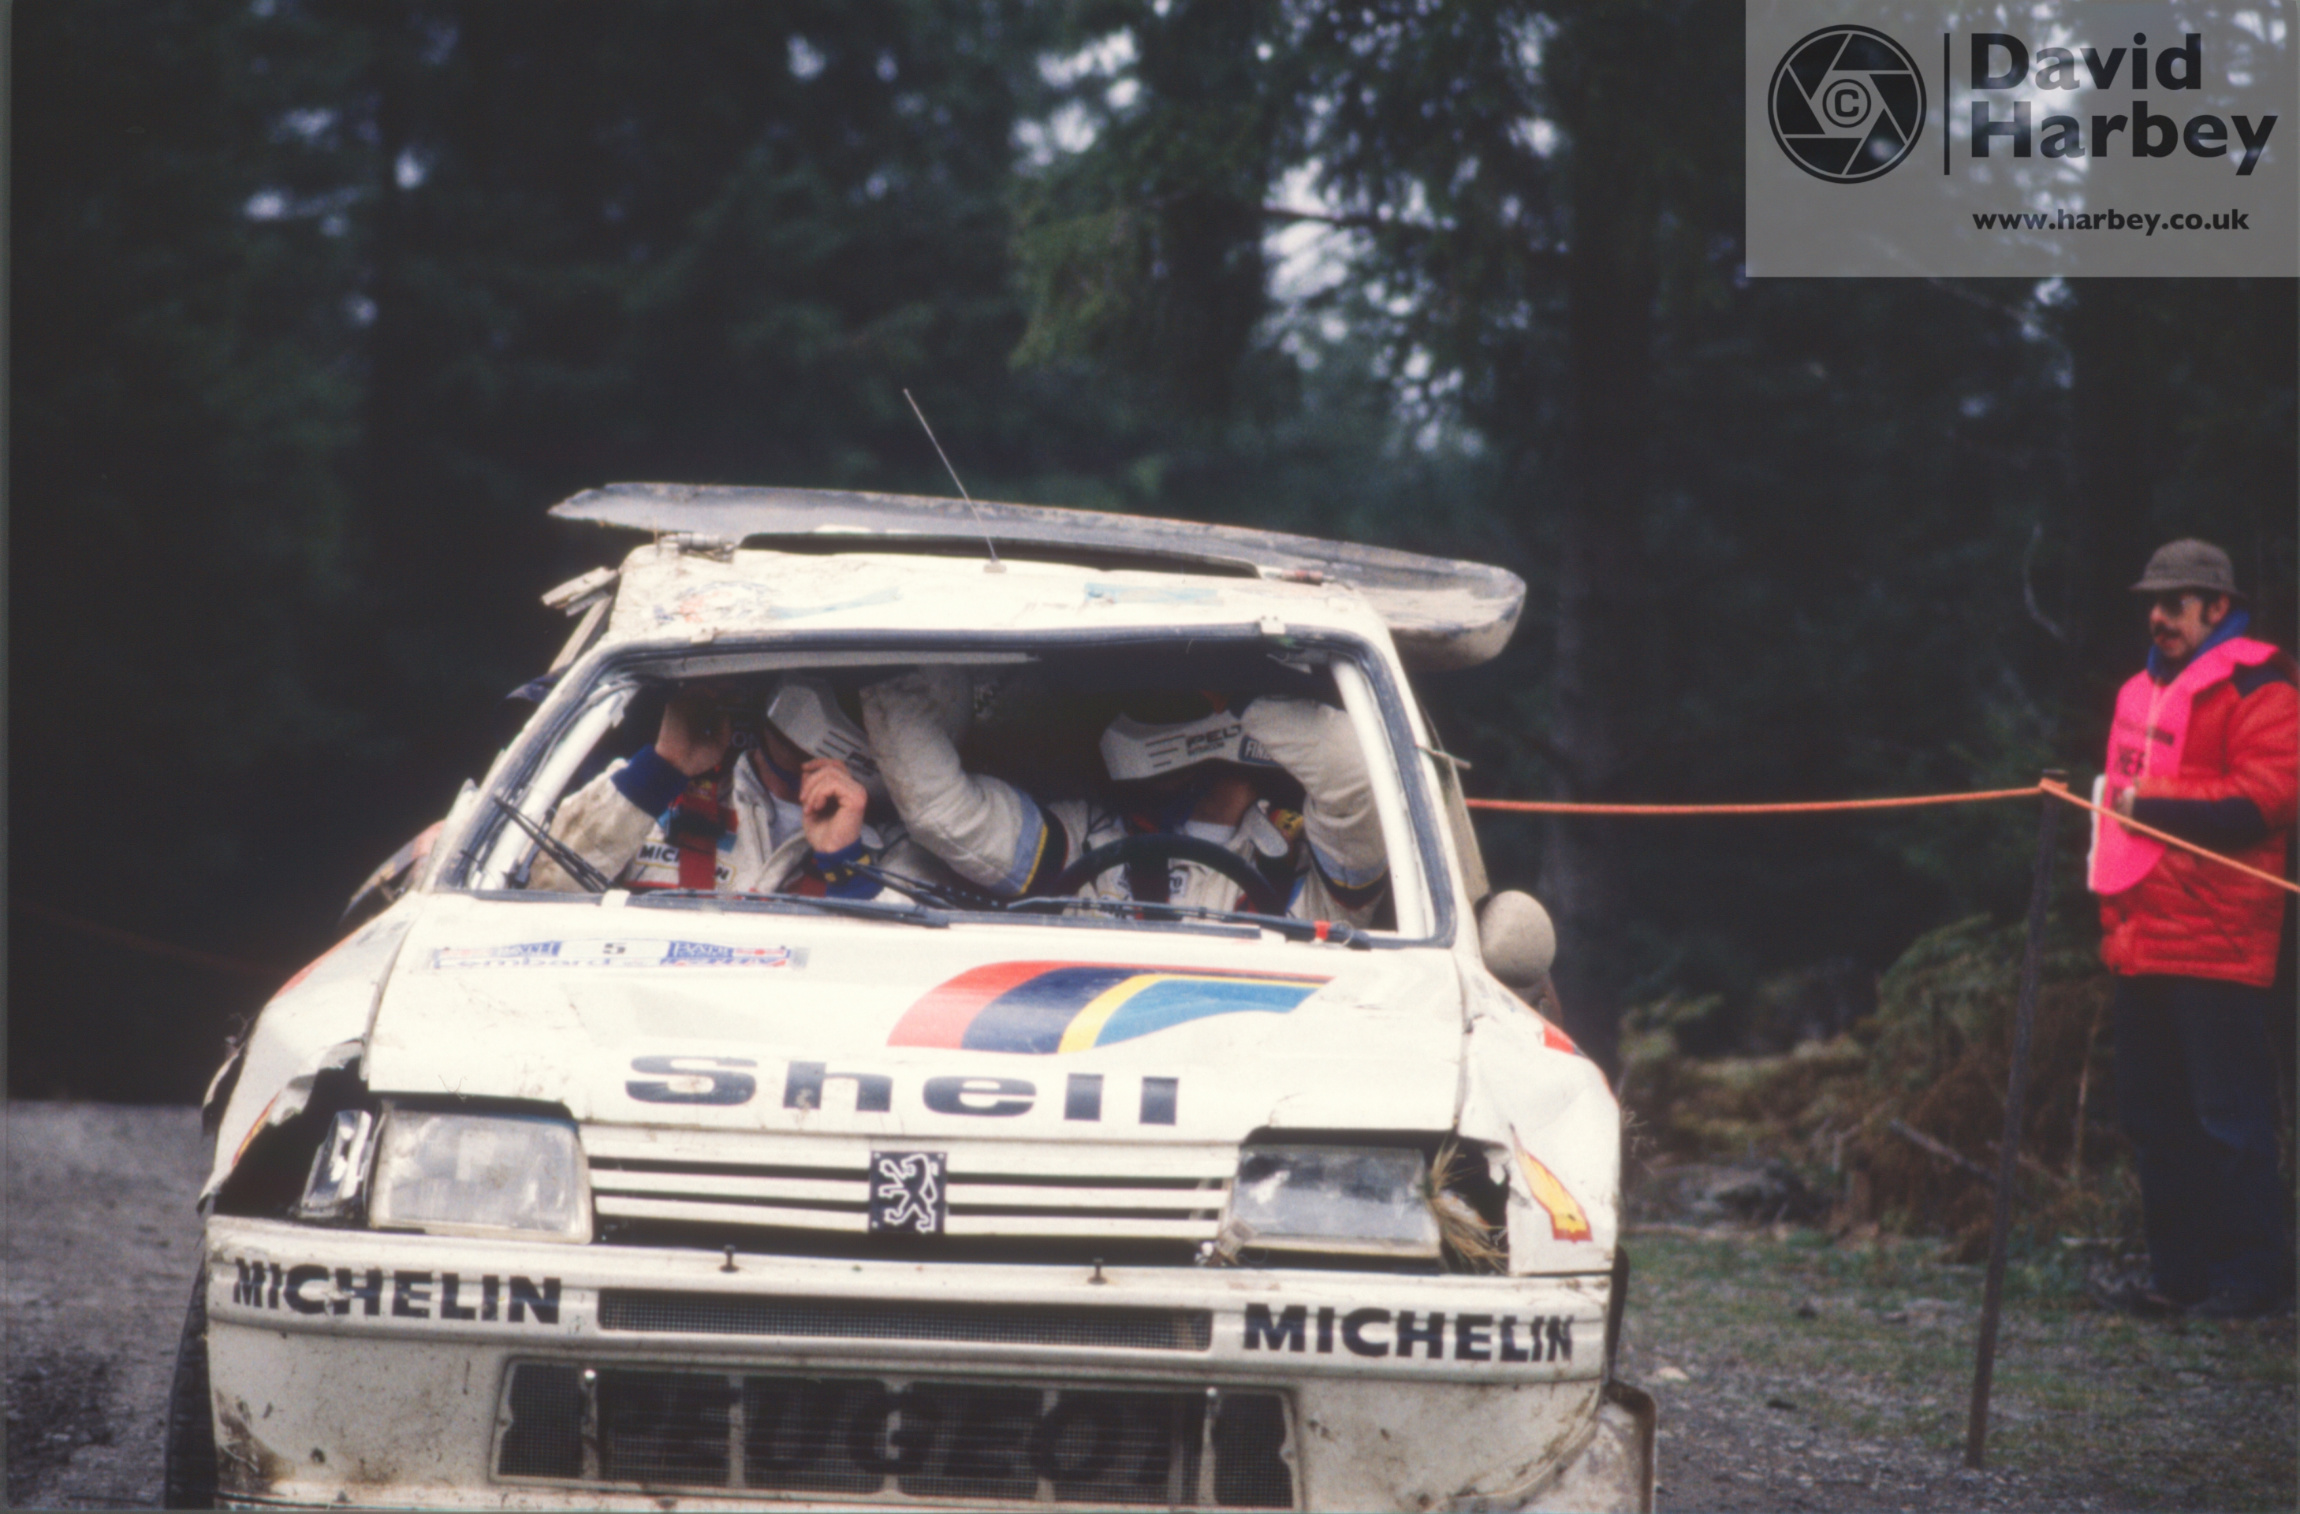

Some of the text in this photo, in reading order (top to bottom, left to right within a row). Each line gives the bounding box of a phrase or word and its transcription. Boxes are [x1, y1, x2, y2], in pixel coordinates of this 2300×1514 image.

[602, 942, 626, 955] 5
[624, 1054, 1179, 1126] Shell
[233, 1257, 562, 1325] MICHELIN
[1243, 1302, 1575, 1362] MICHELIN
